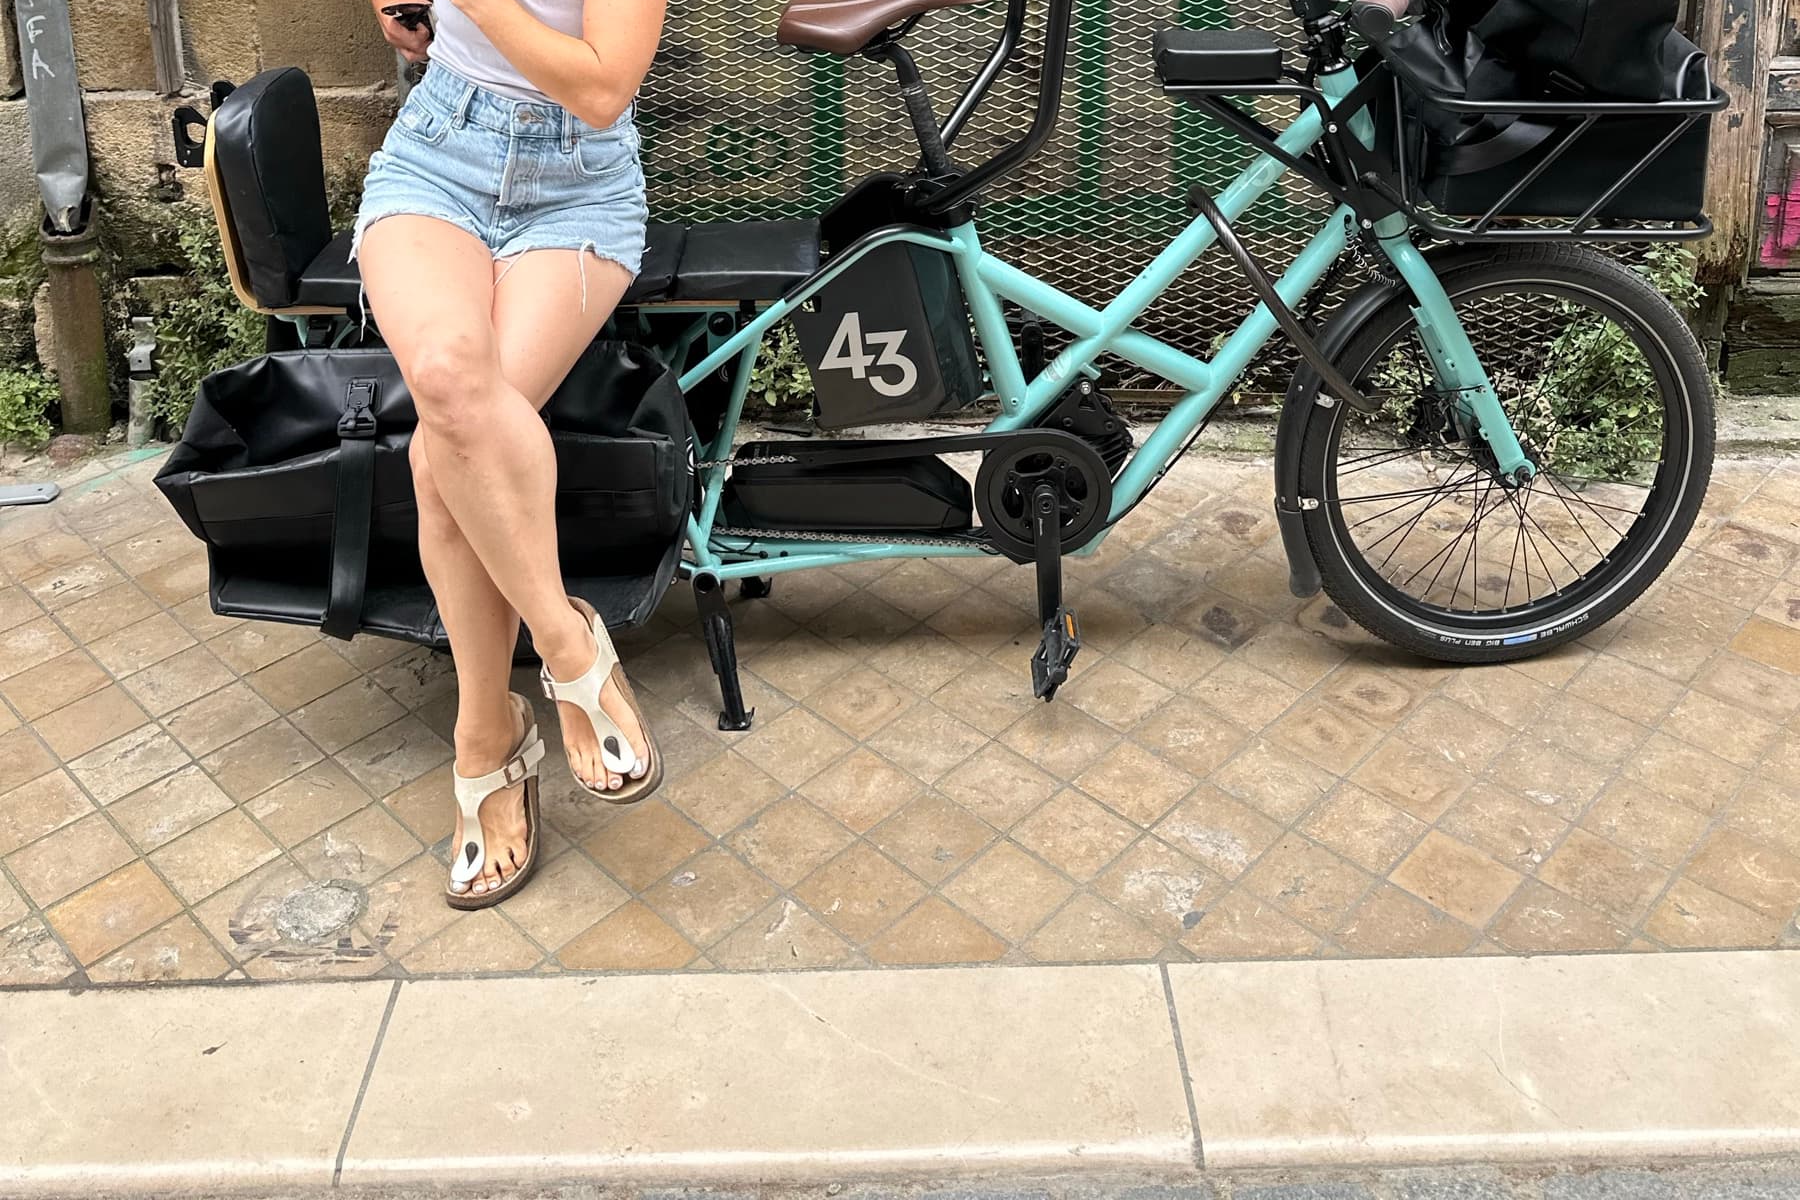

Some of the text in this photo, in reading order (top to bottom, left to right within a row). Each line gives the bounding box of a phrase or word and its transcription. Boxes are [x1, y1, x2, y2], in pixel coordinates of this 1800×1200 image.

[818, 311, 918, 397] 43
[1540, 612, 1589, 639] SCHWALBE
[1439, 636, 1462, 646] PLUS
[1485, 639, 1500, 647] BIG
